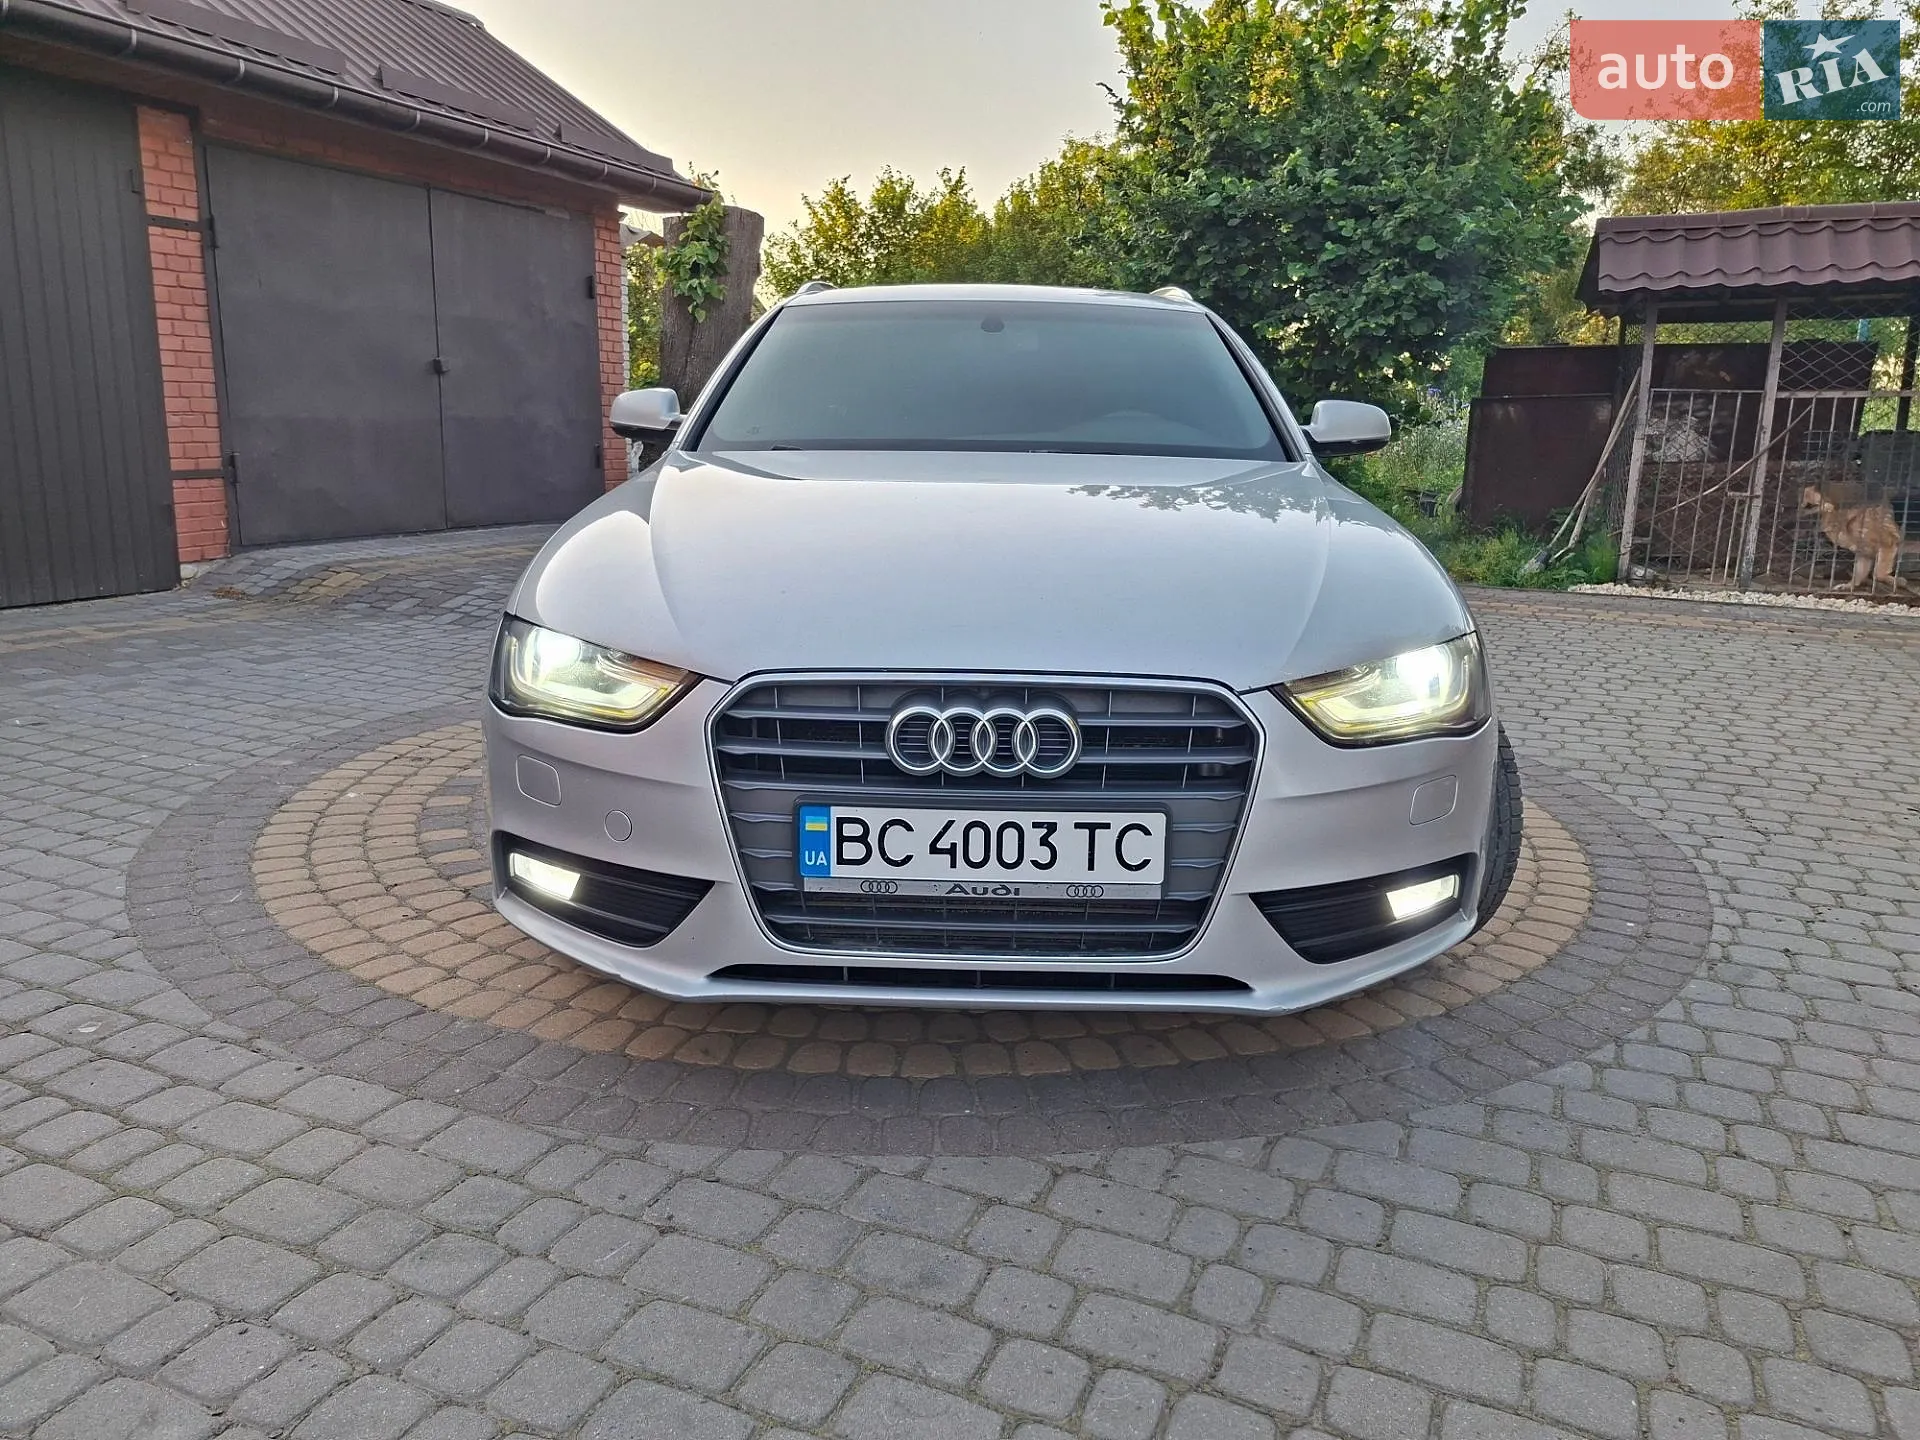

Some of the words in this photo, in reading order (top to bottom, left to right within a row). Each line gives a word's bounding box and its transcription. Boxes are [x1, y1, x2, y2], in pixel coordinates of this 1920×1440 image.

[835, 816, 915, 868] BC
[929, 820, 1058, 871] 4003
[1074, 822, 1153, 872] TC
[805, 851, 828, 867] UA
[945, 883, 1020, 897] Audi
